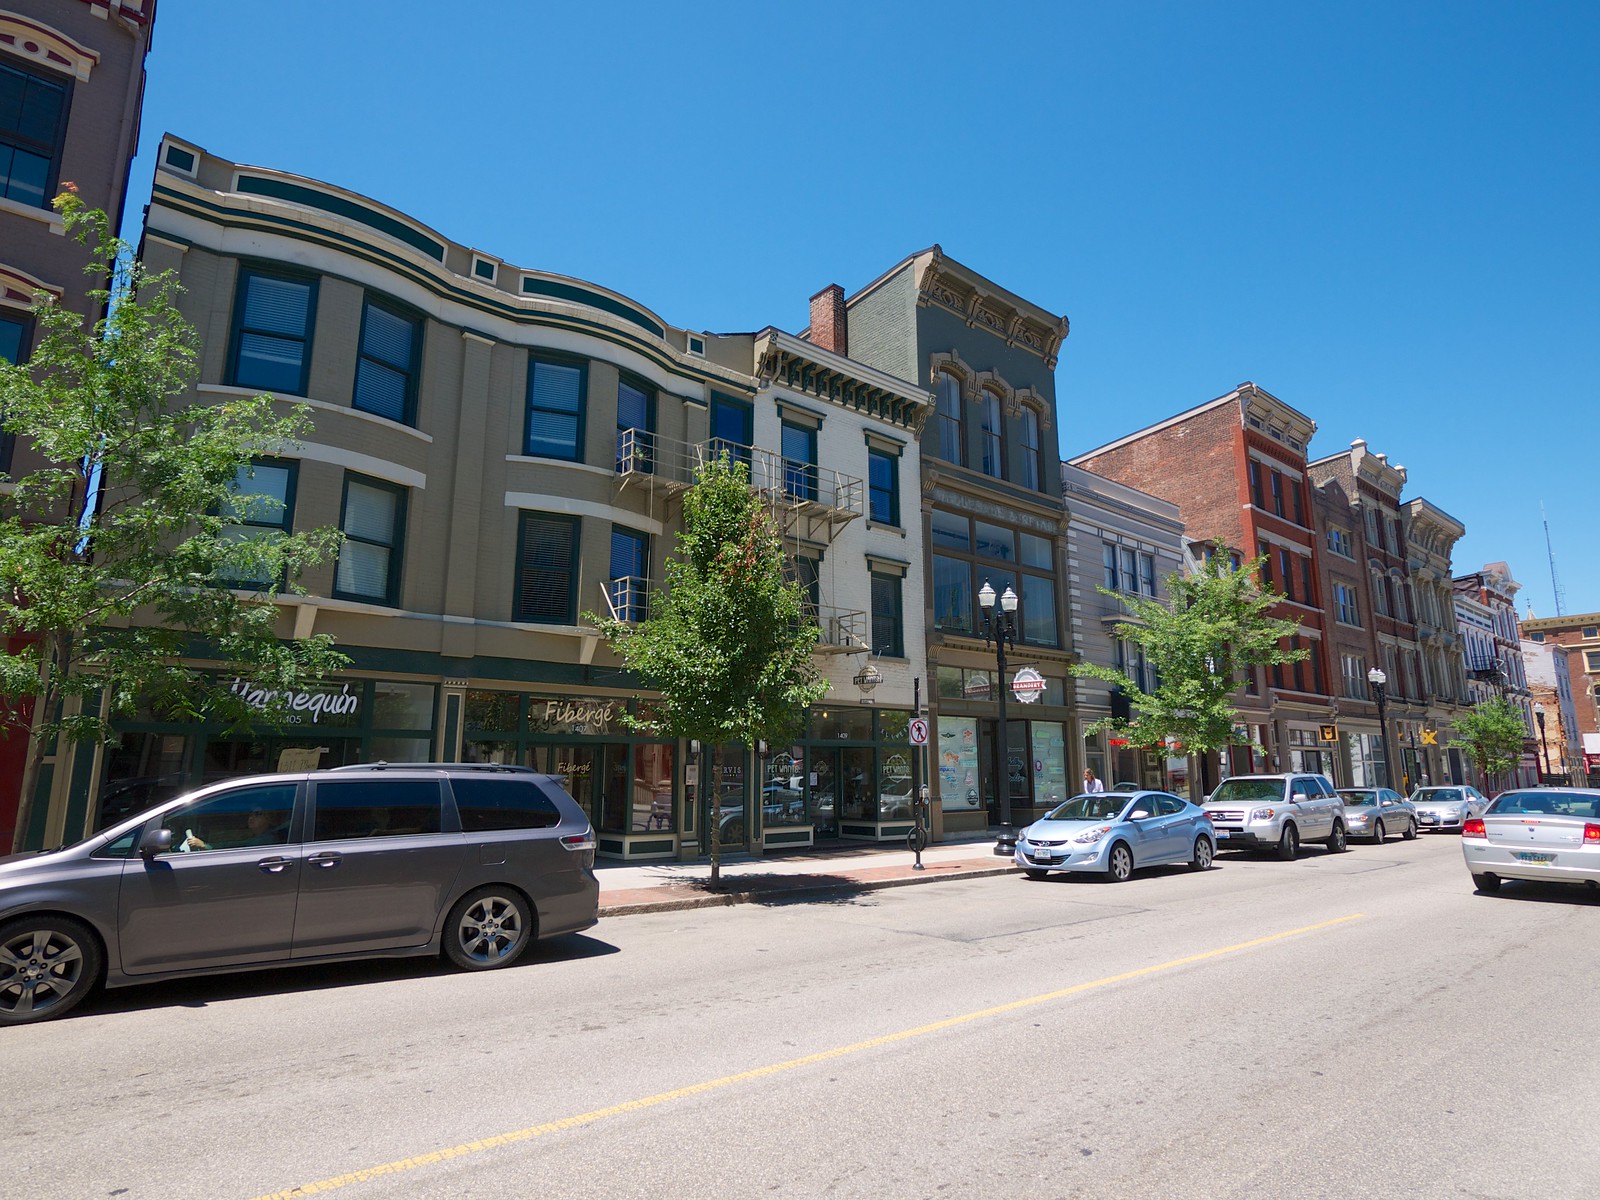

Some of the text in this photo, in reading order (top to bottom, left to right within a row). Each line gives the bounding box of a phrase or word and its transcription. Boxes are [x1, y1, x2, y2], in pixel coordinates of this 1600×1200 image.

[545, 700, 614, 727] Fibergé
[571, 724, 587, 732] 1407
[557, 761, 591, 775] Fibergé
[767, 765, 778, 773] PET
[883, 765, 892, 774] PET
